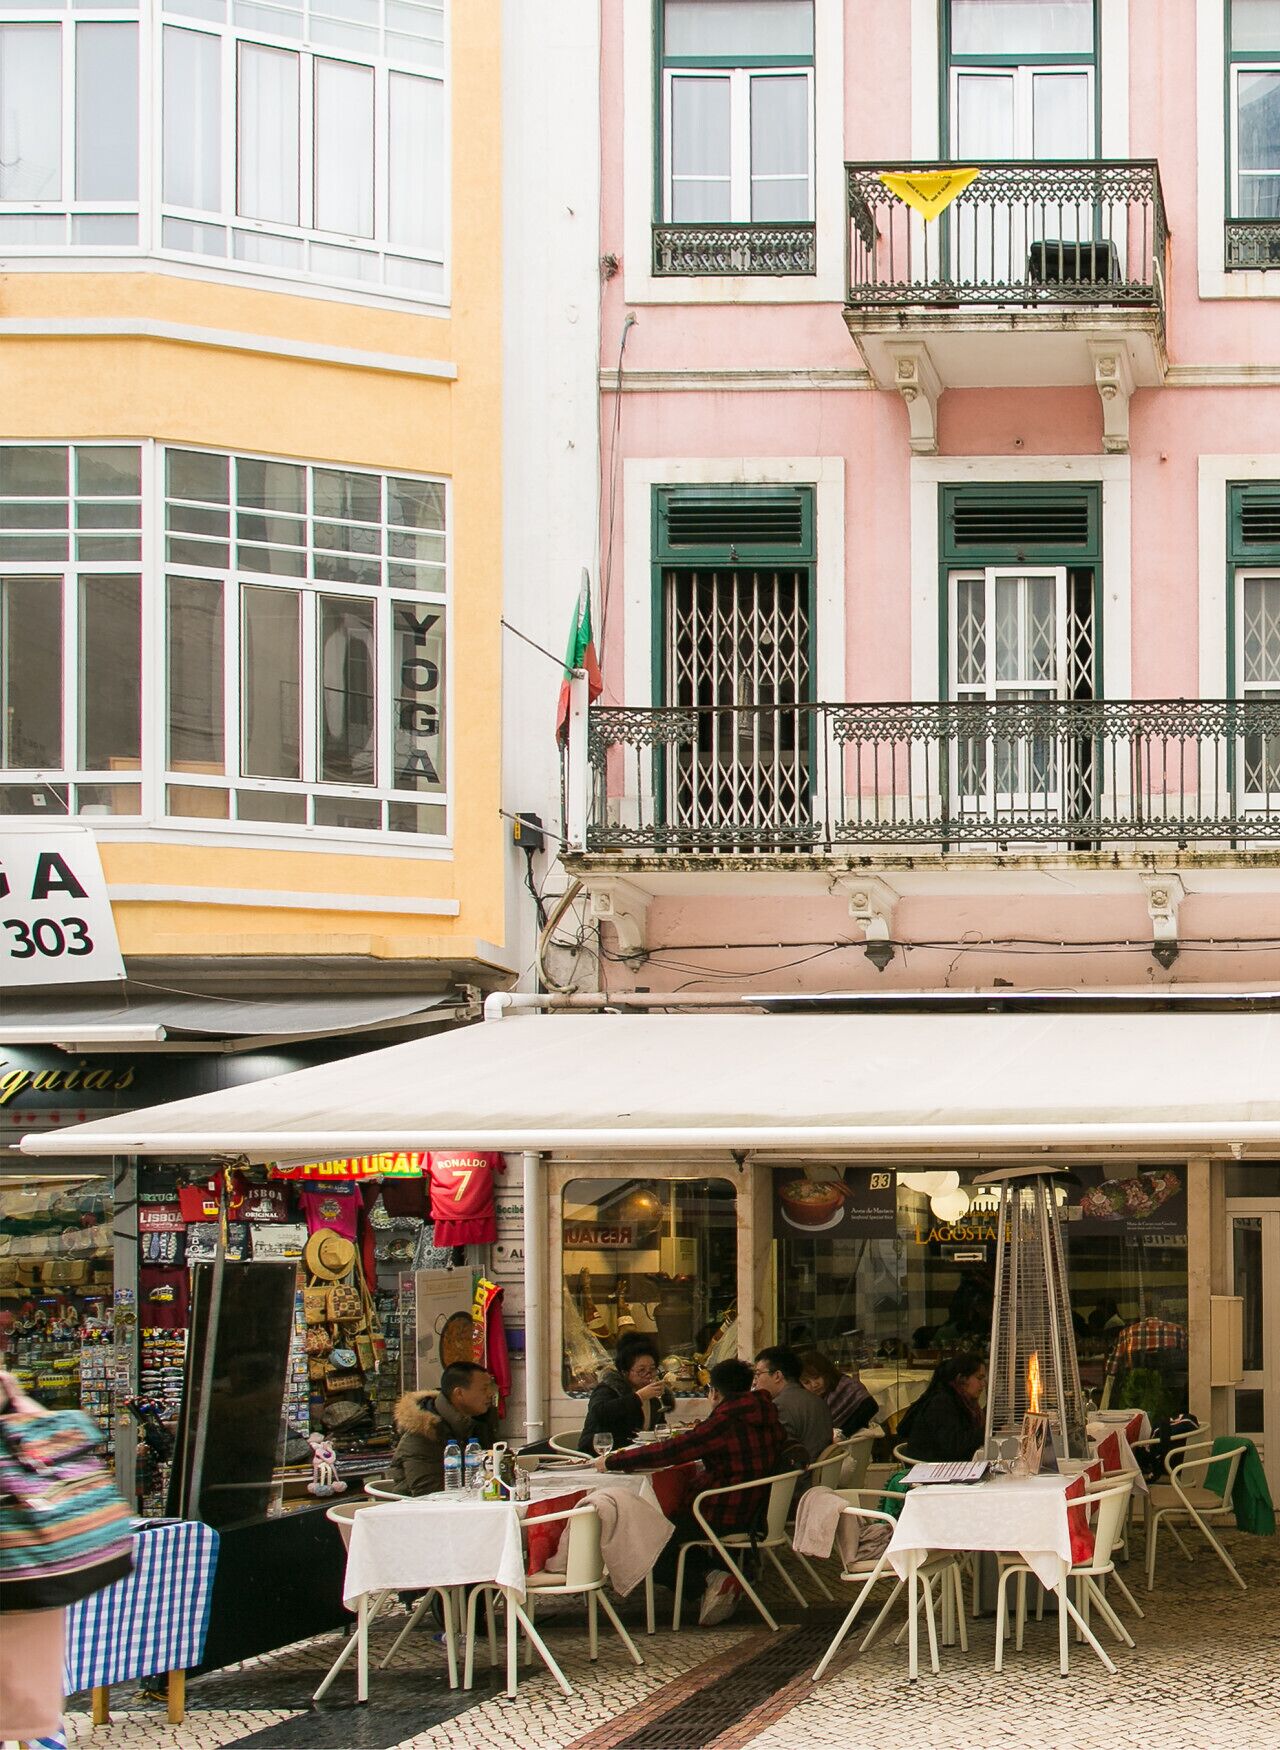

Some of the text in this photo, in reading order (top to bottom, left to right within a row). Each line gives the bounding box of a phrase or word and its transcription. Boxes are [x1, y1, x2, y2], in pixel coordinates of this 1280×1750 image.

[400, 611, 441, 784] YOGA
[2, 917, 94, 959] 303
[437, 1158, 487, 1169] RONALDO
[452, 1170, 472, 1201] 7
[871, 1173, 890, 1188] 33
[140, 1211, 184, 1223] LISBOA
[914, 1223, 996, 1245] LAGOSTA
